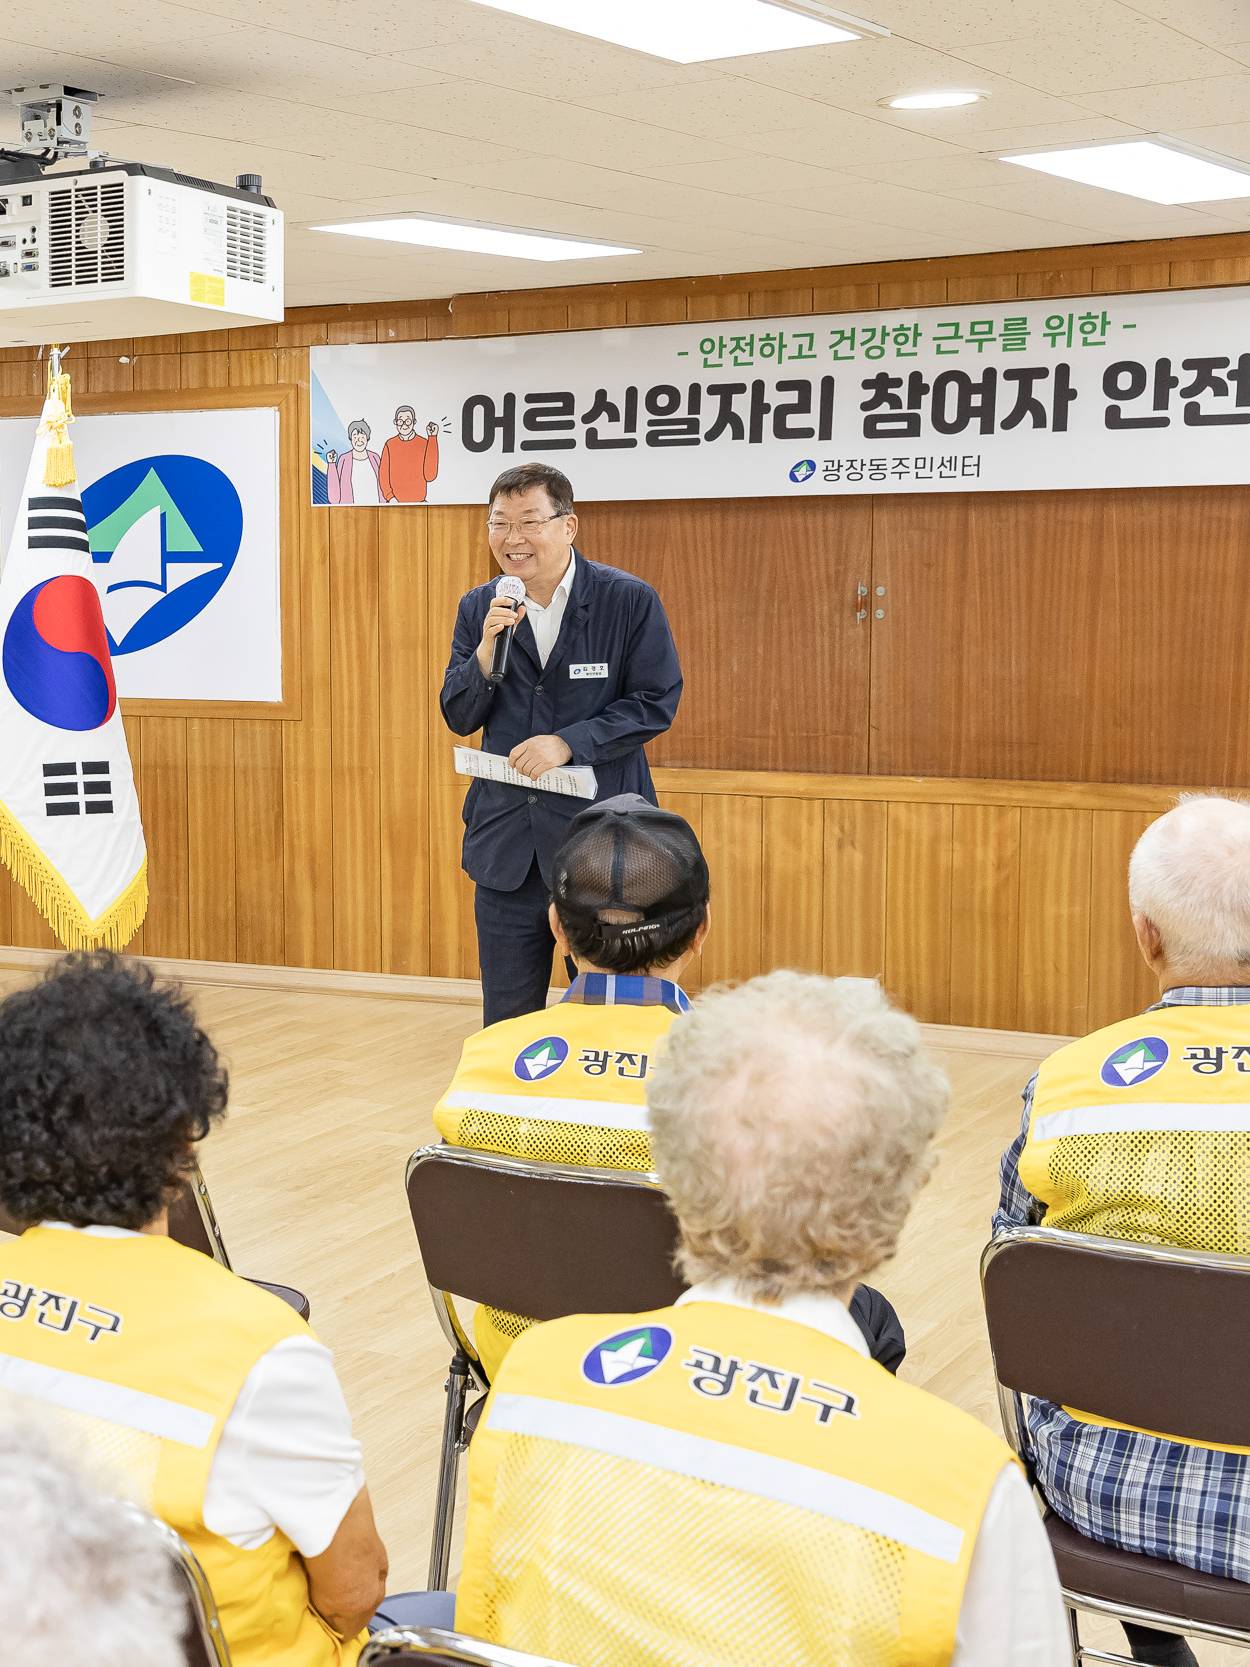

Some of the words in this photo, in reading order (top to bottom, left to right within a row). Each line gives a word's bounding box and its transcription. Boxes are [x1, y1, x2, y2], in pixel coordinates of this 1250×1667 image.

[698, 331, 818, 369] 안전하고
[828, 322, 924, 362] 건강한
[932, 316, 1032, 356] 근무를
[1042, 311, 1112, 349] 위한
[461, 375, 835, 453] 어르신일자리
[859, 362, 1078, 439] 참여자
[1102, 351, 1250, 430] 안전
[821, 453, 982, 483] 광장동주민센터
[578, 1049, 659, 1079] 광진
[684, 1348, 857, 1423] 광진구
